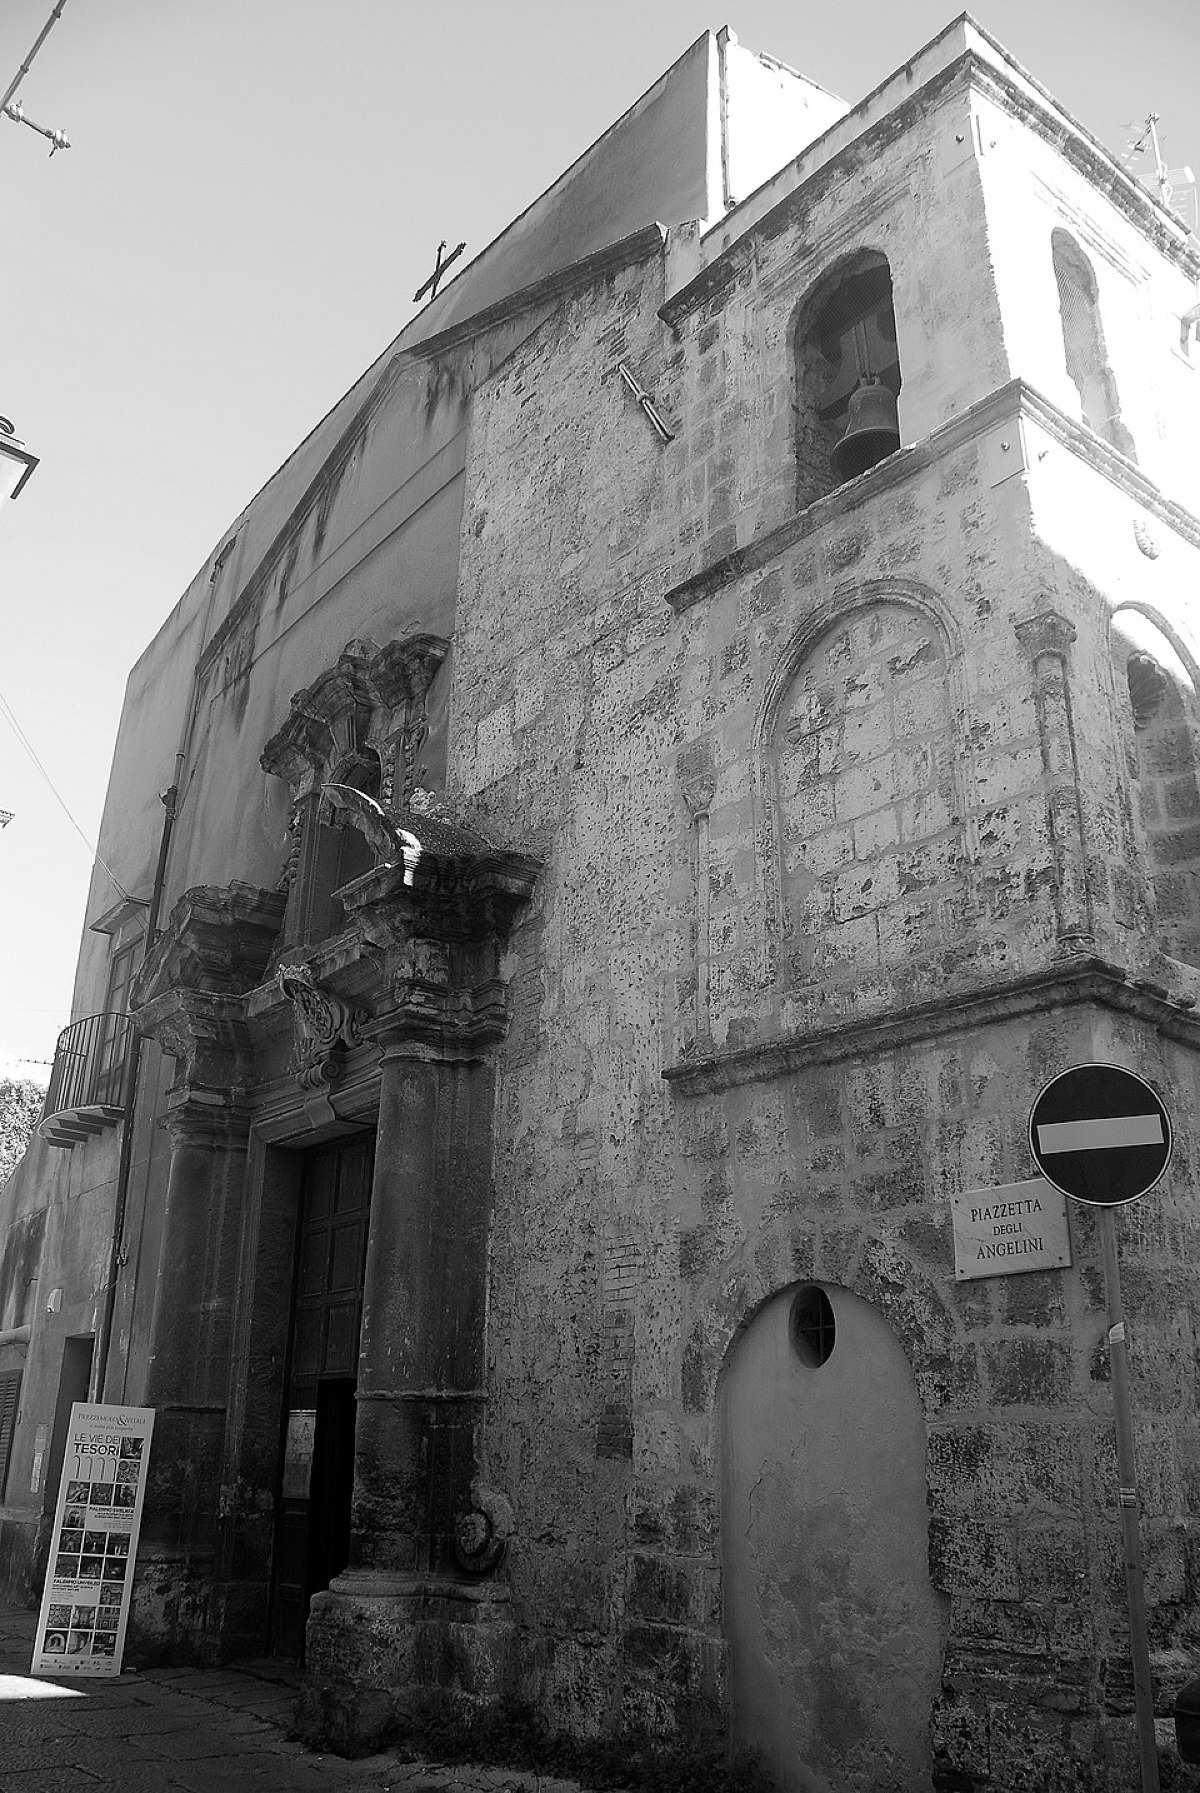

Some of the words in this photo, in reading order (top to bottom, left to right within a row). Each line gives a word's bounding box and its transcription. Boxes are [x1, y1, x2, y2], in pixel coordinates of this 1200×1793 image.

[971, 1199, 1042, 1222] PIAZZETTA
[993, 1222, 1022, 1236] DEGLI
[976, 1237, 1044, 1259] ANGELINI
[74, 1433, 86, 1442] LE
[89, 1433, 104, 1443] VIE
[105, 1435, 120, 1444] DEI
[74, 1443, 119, 1456] TESORI
